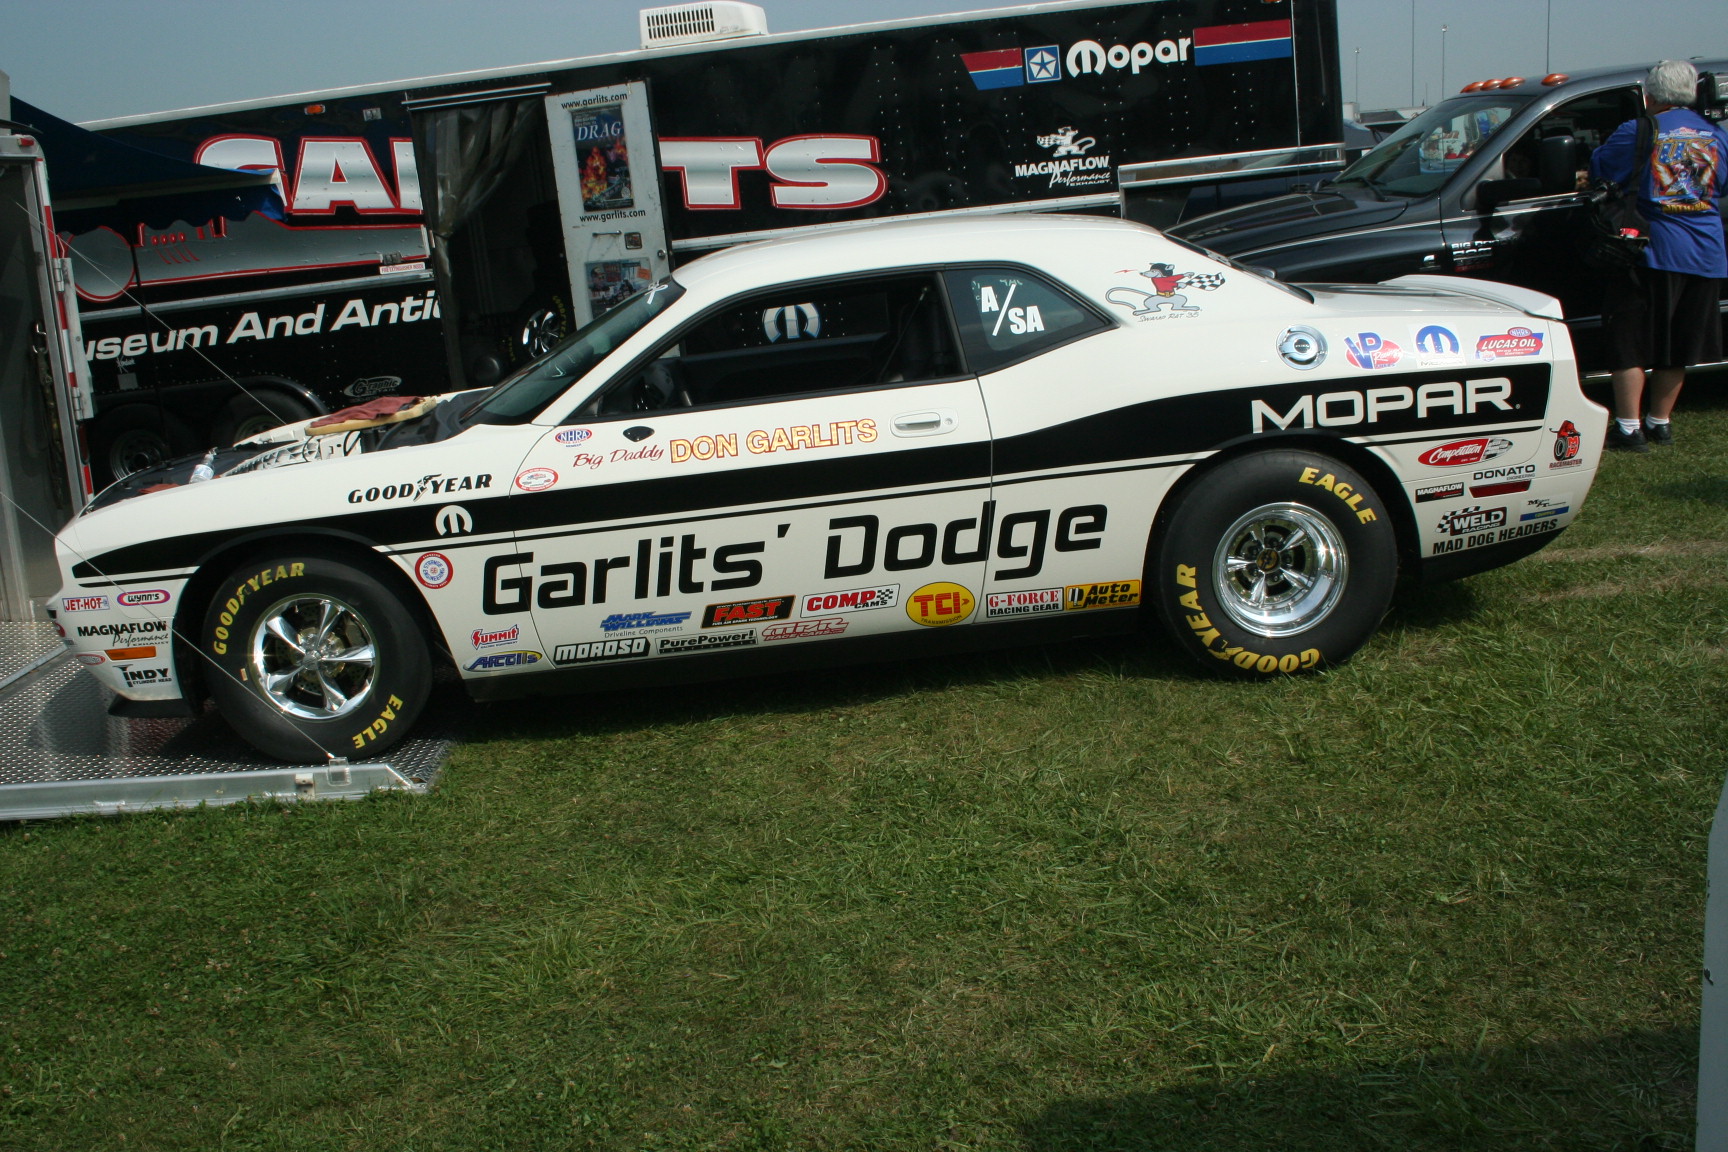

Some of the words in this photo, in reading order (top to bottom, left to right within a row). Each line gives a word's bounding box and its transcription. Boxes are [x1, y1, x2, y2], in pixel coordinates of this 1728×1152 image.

[1066, 38, 1191, 78] Mopar
[577, 121, 623, 141] DRAG
[1015, 156, 1109, 177] MAGNAFLOW
[1049, 170, 1110, 188] Performance
[580, 209, 646, 222] www.garlits.com
[226, 304, 324, 344] And
[1481, 339, 1517, 350] LUCAS
[1519, 338, 1537, 348] OIL
[1252, 377, 1514, 433] MOPAR
[560, 430, 588, 441] NHRA
[573, 453, 603, 470] Big
[610, 444, 664, 464] Daddy
[670, 433, 738, 463] DON
[746, 418, 878, 454] GARLITS
[1429, 443, 1482, 463] Competition
[1473, 464, 1536, 480] DONATO
[1549, 459, 1583, 468] RACEMASTER
[1299, 467, 1377, 524] EAGLE
[1417, 483, 1463, 496] MAGNAFLOW
[1453, 510, 1504, 531] WELD
[1461, 523, 1500, 534] RACING
[1433, 538, 1464, 554] MAD
[1467, 532, 1495, 548] DOG
[1498, 518, 1559, 540] HEADERS
[483, 523, 791, 615] Garlits'
[824, 500, 1109, 581] Dodge
[989, 590, 1059, 608] G-FORCE
[1084, 593, 1138, 605] Meter
[1088, 583, 1131, 595] Auto
[213, 562, 305, 655] GOODYEAR
[807, 590, 876, 612] COMP
[854, 600, 887, 609] CAMS
[914, 591, 960, 617] TCI
[990, 604, 1030, 616] RACING
[1032, 603, 1059, 612] GEAR
[713, 601, 781, 622] FAST
[920, 615, 962, 625] TRANSMISSION
[1176, 563, 1320, 673] GOODYEAR
[78, 621, 167, 637] MAGNAFLOW
[638, 626, 683, 635] Components
[555, 638, 646, 661] MOROSO
[660, 630, 755, 649] PurePower!
[352, 693, 404, 749] EAGLE
